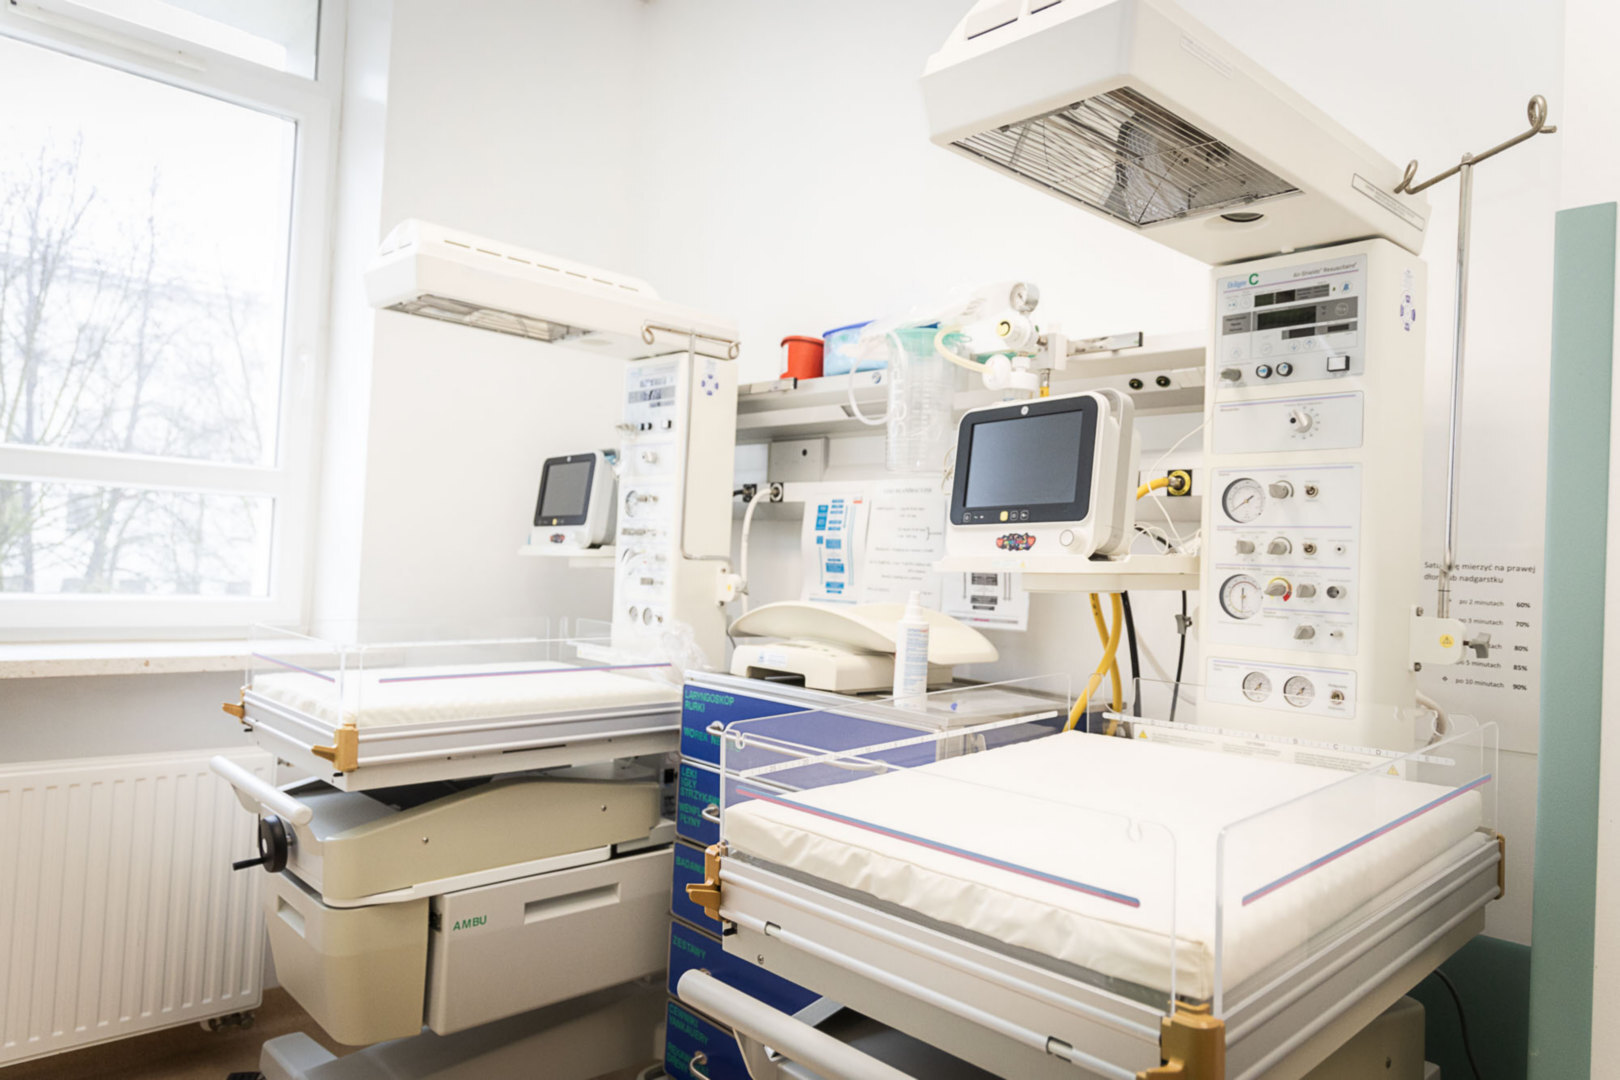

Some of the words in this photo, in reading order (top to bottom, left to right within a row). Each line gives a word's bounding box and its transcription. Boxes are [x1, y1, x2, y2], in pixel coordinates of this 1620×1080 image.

[1248, 273, 1259, 286] C
[1462, 564, 1493, 572] mierzyć
[1507, 566, 1536, 574] prawej
[1459, 575, 1504, 584] nadgarstku
[1474, 680, 1505, 688] minutach
[684, 689, 735, 706] LARYNGOSKOP
[684, 700, 706, 713] RURKI
[681, 766, 698, 779] LEKI
[453, 915, 487, 931] AMBU
